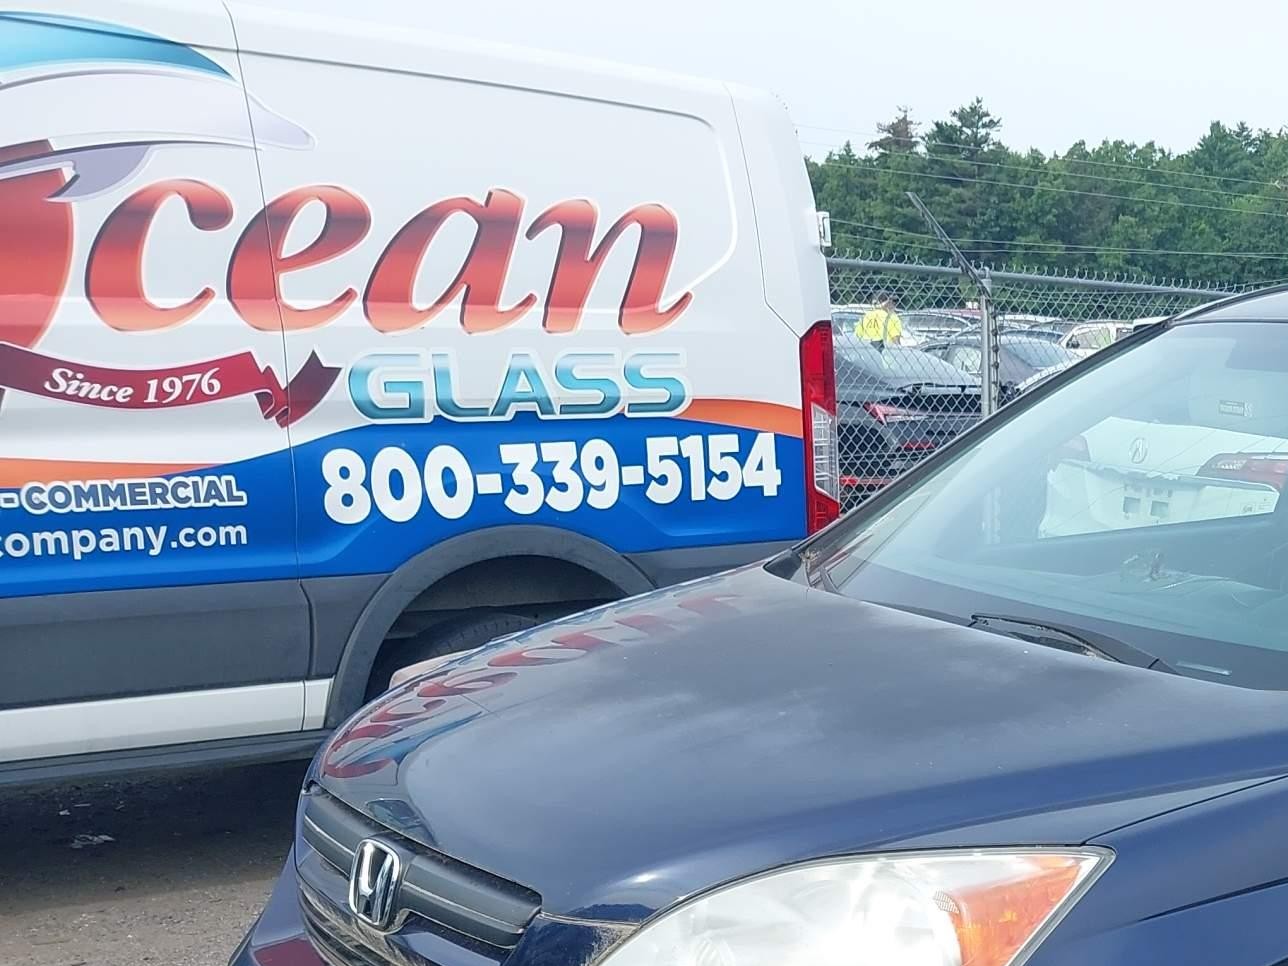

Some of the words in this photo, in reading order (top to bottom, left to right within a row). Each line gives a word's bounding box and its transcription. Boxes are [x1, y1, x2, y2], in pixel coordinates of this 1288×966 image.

[44, 367, 134, 402] Since
[143, 368, 222, 404] 1976
[347, 350, 690, 421] GLASS
[321, 432, 782, 525] 800-339-5154
[0, 525, 248, 560] ompany.com
